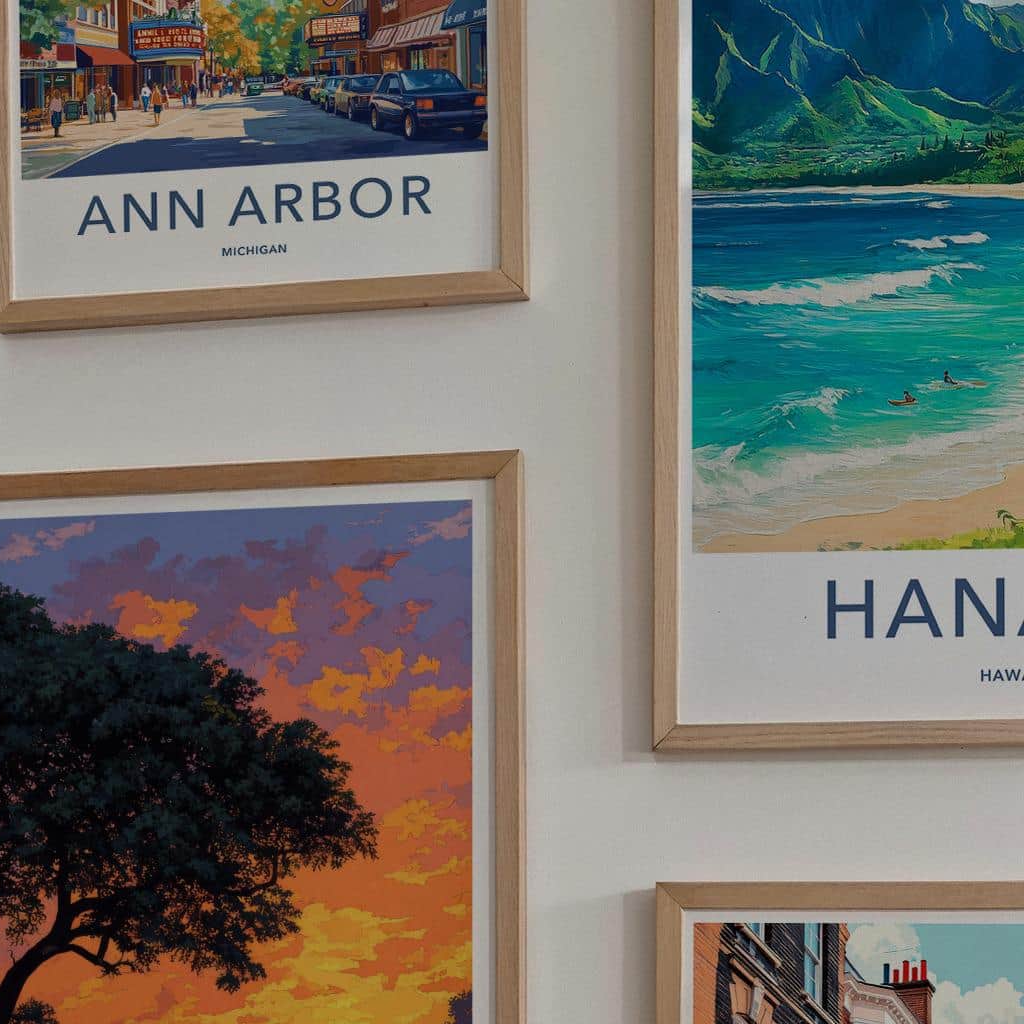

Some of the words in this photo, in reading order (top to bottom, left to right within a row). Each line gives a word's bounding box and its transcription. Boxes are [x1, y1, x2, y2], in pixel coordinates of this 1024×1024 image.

[77, 189, 205, 236] ANN
[228, 175, 432, 227] ARBOR
[221, 243, 288, 257] MICHIGAN
[826, 577, 1024, 639] HAN
[980, 668, 1024, 682] HAW
